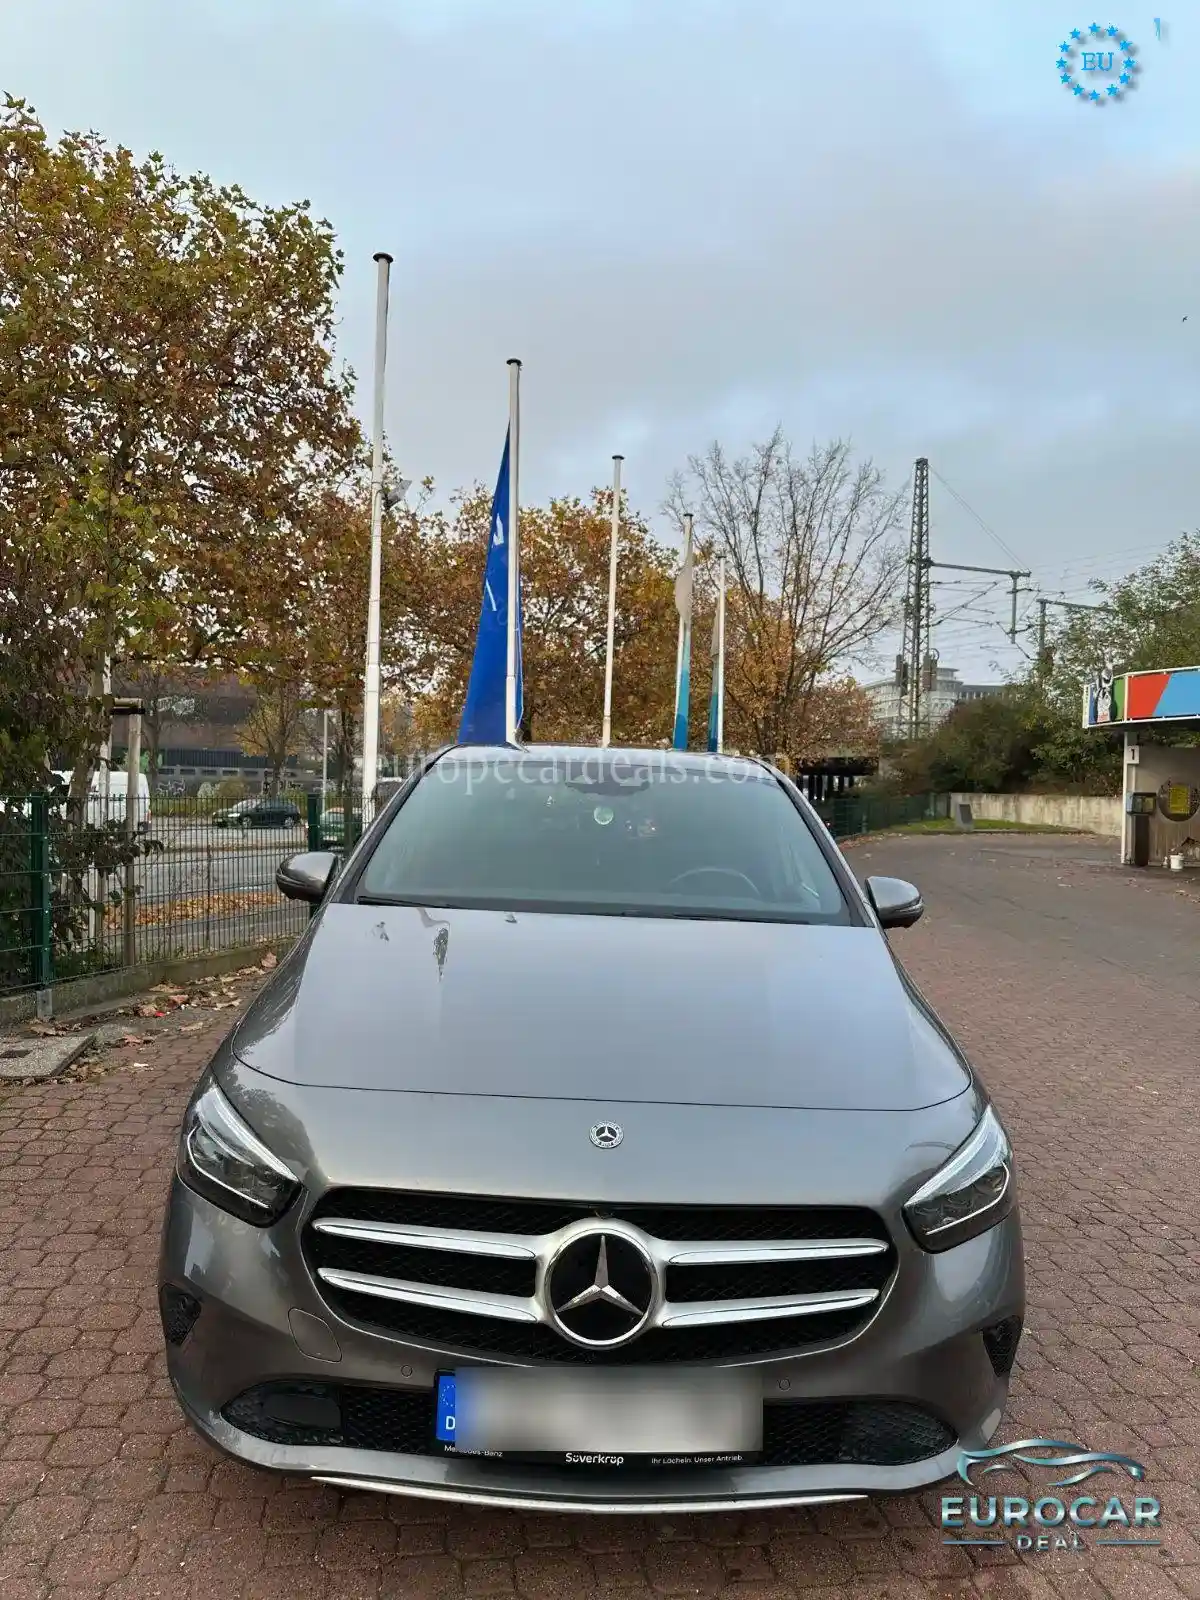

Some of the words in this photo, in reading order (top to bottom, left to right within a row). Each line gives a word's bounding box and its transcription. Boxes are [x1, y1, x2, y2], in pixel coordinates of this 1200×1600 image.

[445, 1415, 456, 1430] D
[444, 1444, 503, 1457] Mees-Benz
[565, 1452, 625, 1467] Süverkrüp
